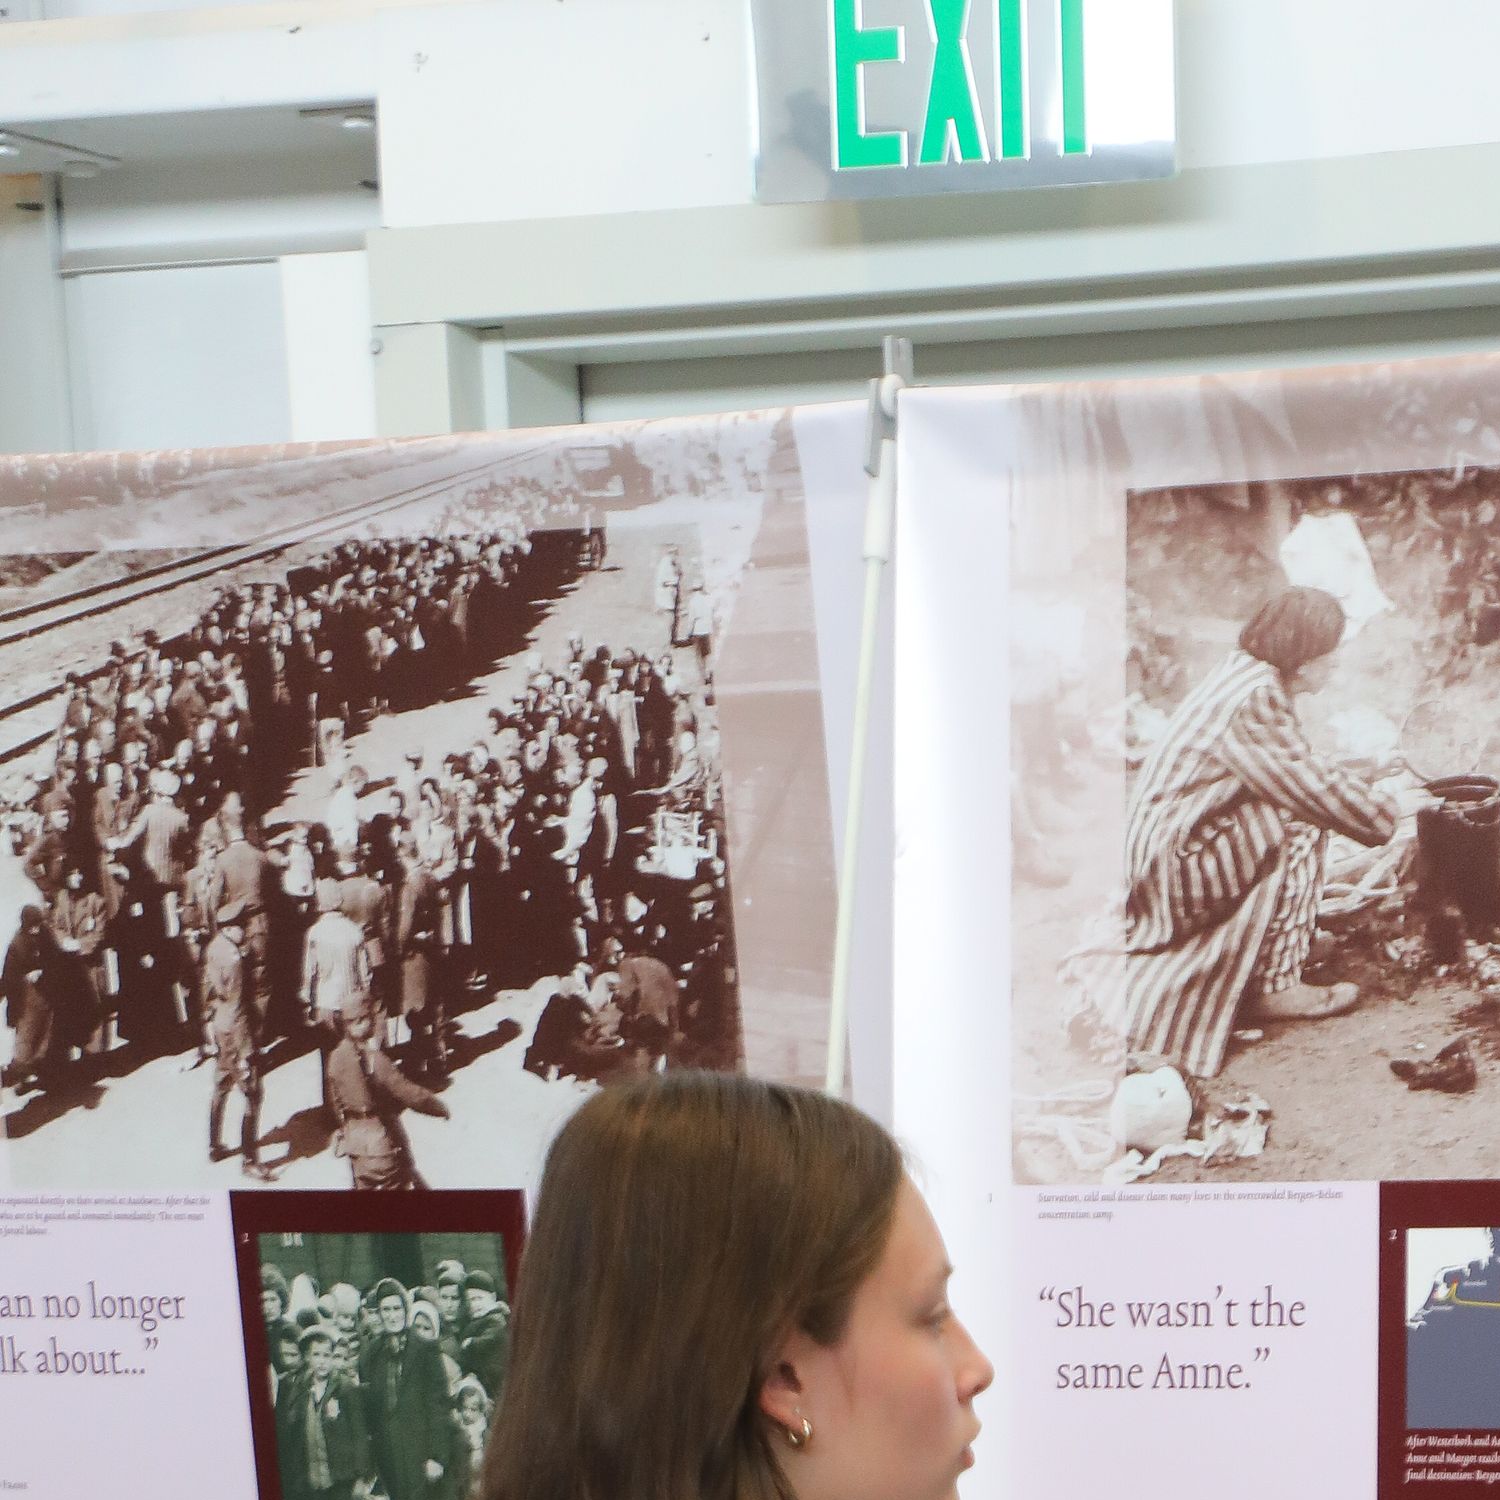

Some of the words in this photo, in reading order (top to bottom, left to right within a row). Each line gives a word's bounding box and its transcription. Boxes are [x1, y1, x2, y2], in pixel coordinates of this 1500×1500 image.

[44, 1293, 81, 1319] no
[89, 1280, 187, 1332] longer
[1039, 1285, 1115, 1327] “She
[1126, 1285, 1239, 1327] wasn’t
[1249, 1284, 1305, 1327] the
[36, 1335, 160, 1376] about...”
[1056, 1363, 1143, 1389] same
[1151, 1346, 1270, 1389] Anne.”
